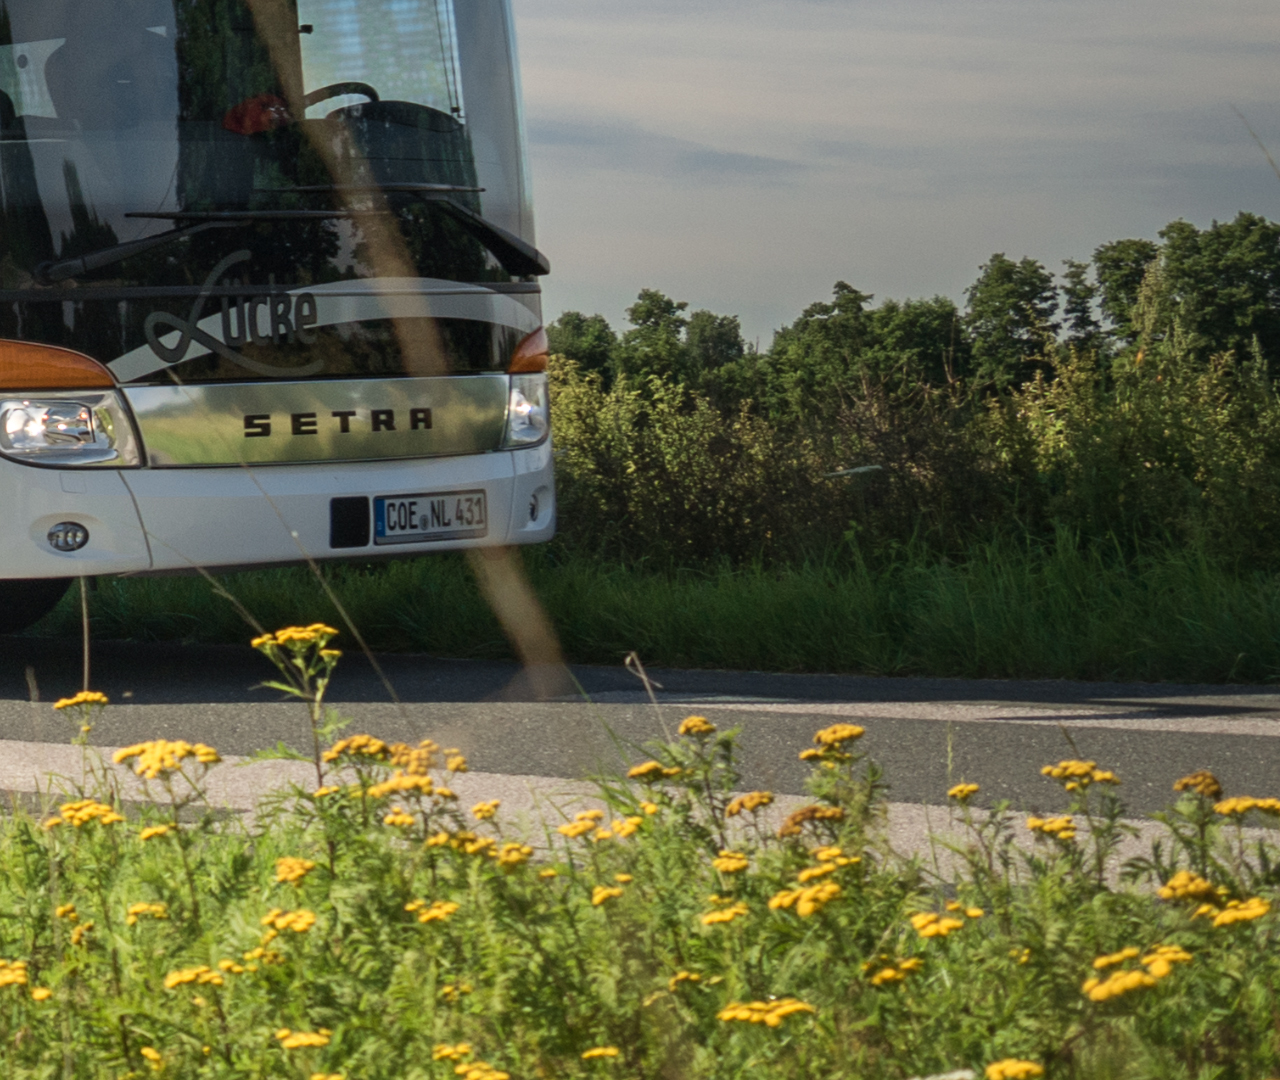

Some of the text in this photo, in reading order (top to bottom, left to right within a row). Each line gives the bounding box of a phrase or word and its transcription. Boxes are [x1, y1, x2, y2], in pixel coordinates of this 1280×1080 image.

[243, 407, 433, 438] SETRA
[386, 496, 484, 531] COE NL 431
